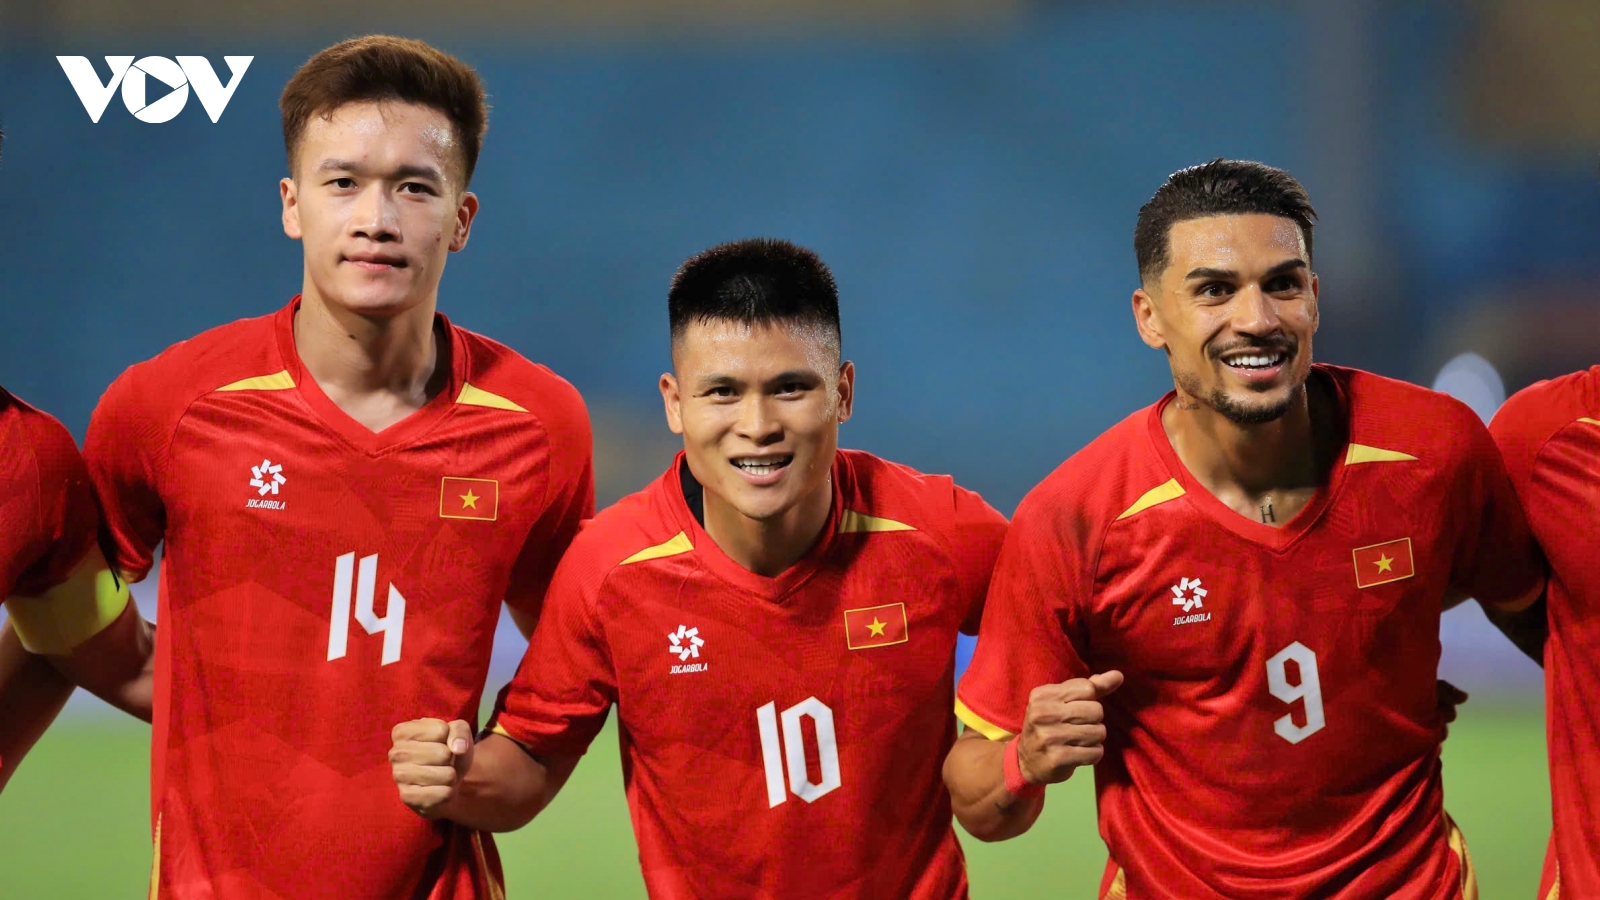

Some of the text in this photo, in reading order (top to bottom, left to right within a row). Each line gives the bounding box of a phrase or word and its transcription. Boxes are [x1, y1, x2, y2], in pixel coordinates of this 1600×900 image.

[246, 499, 286, 510] JOGARBOLA
[327, 552, 406, 666] 14
[1172, 611, 1211, 626] JOGARBOLA
[669, 662, 708, 675] JOGARBOLA
[1266, 641, 1326, 744] 9
[756, 696, 842, 809] 10
